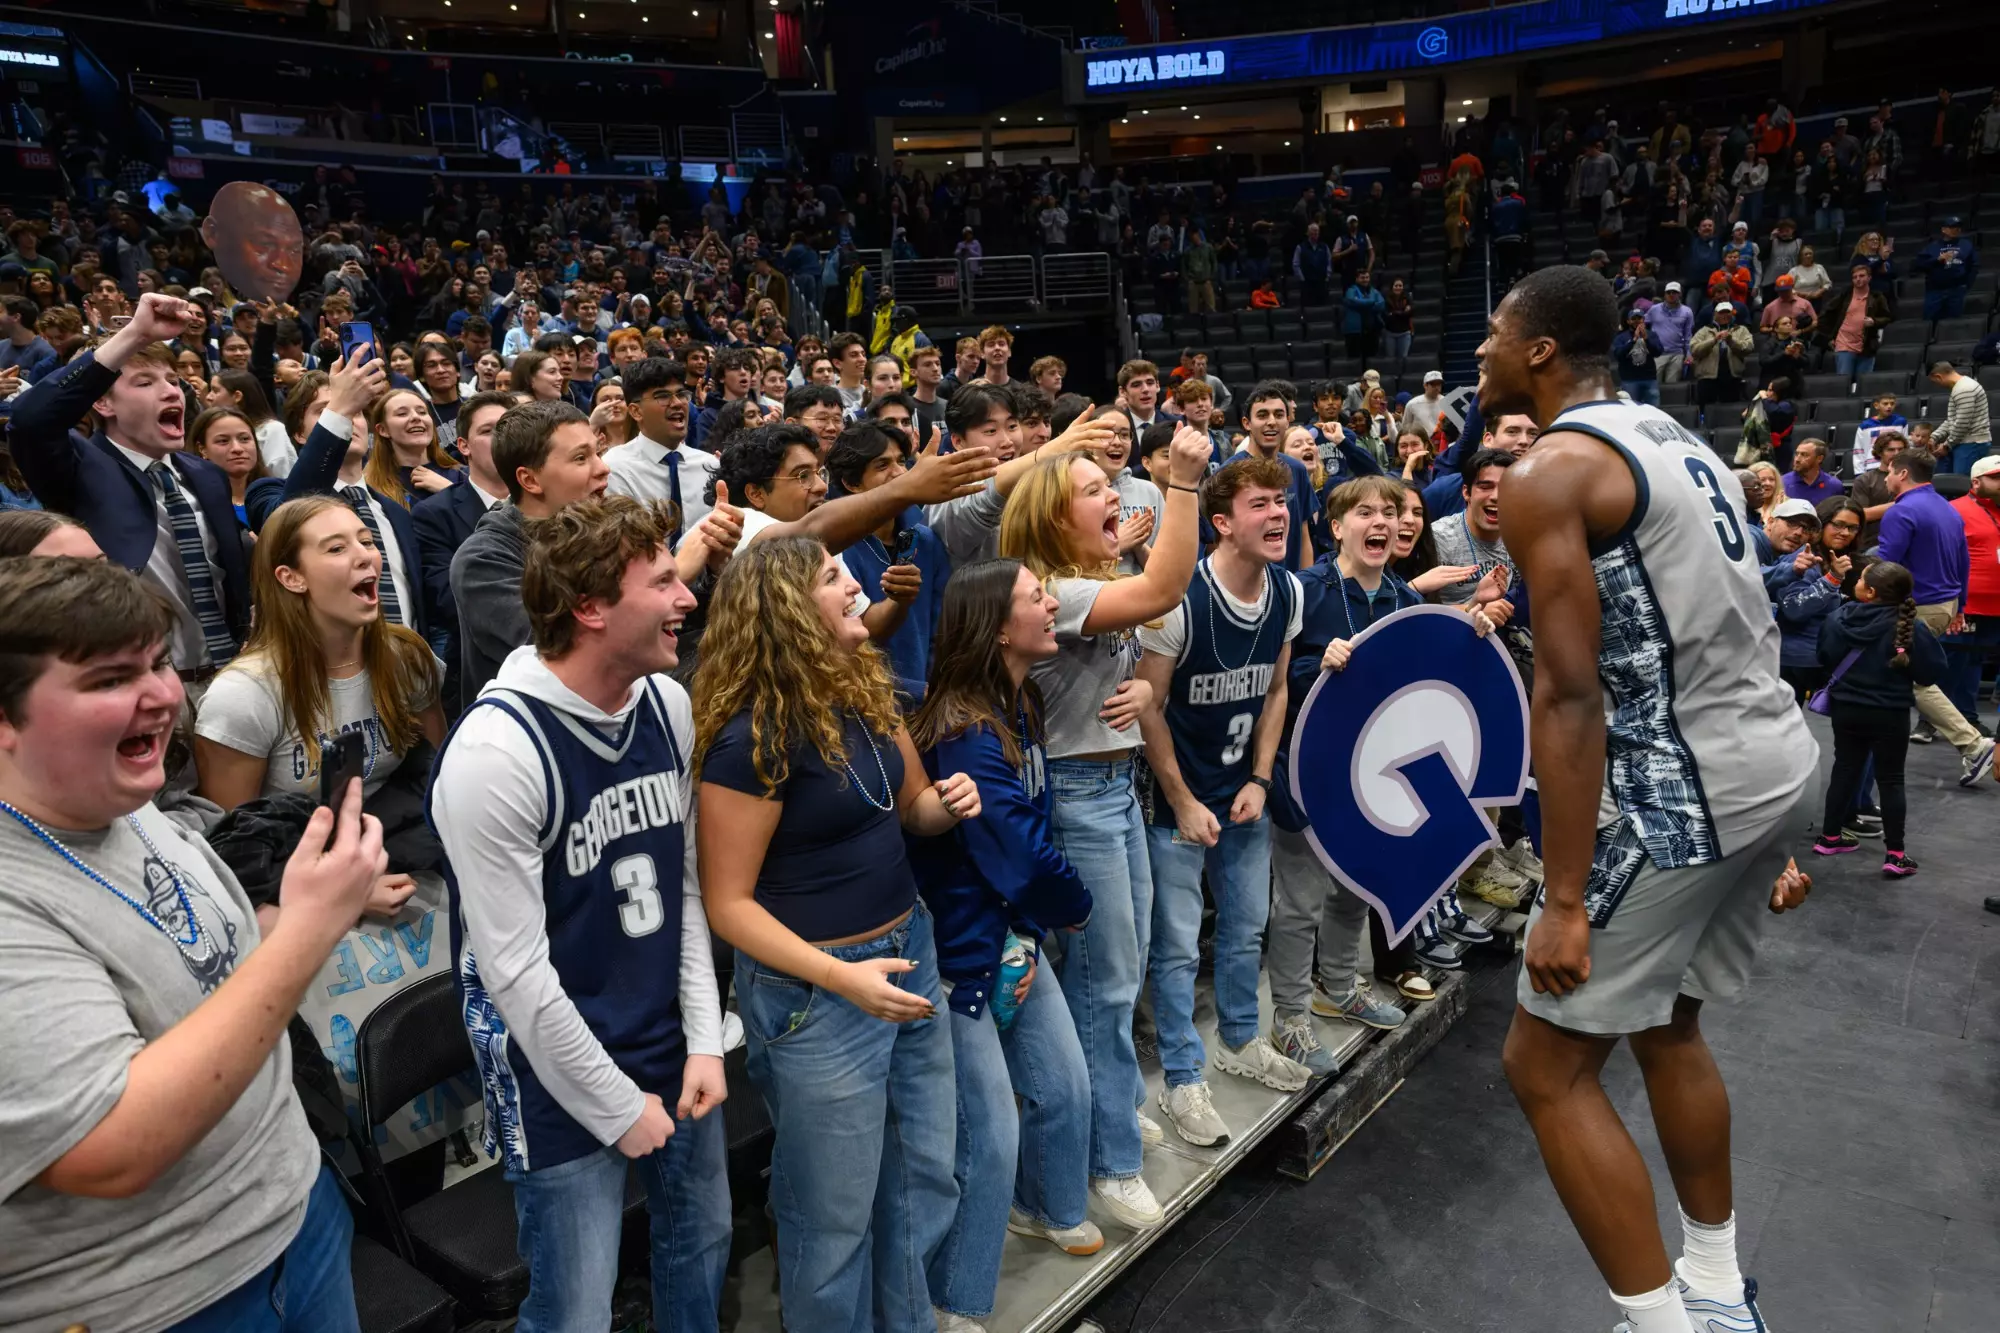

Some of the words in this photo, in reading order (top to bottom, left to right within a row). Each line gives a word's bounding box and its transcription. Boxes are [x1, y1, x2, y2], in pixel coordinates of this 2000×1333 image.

[1088, 57, 1154, 86] HOYA
[1157, 50, 1225, 79] BOLD
[22, 152, 51, 165] 105
[1684, 455, 1746, 564] 3
[1221, 712, 1254, 766] 3
[610, 852, 665, 939] 3
[327, 909, 437, 998] ARE
